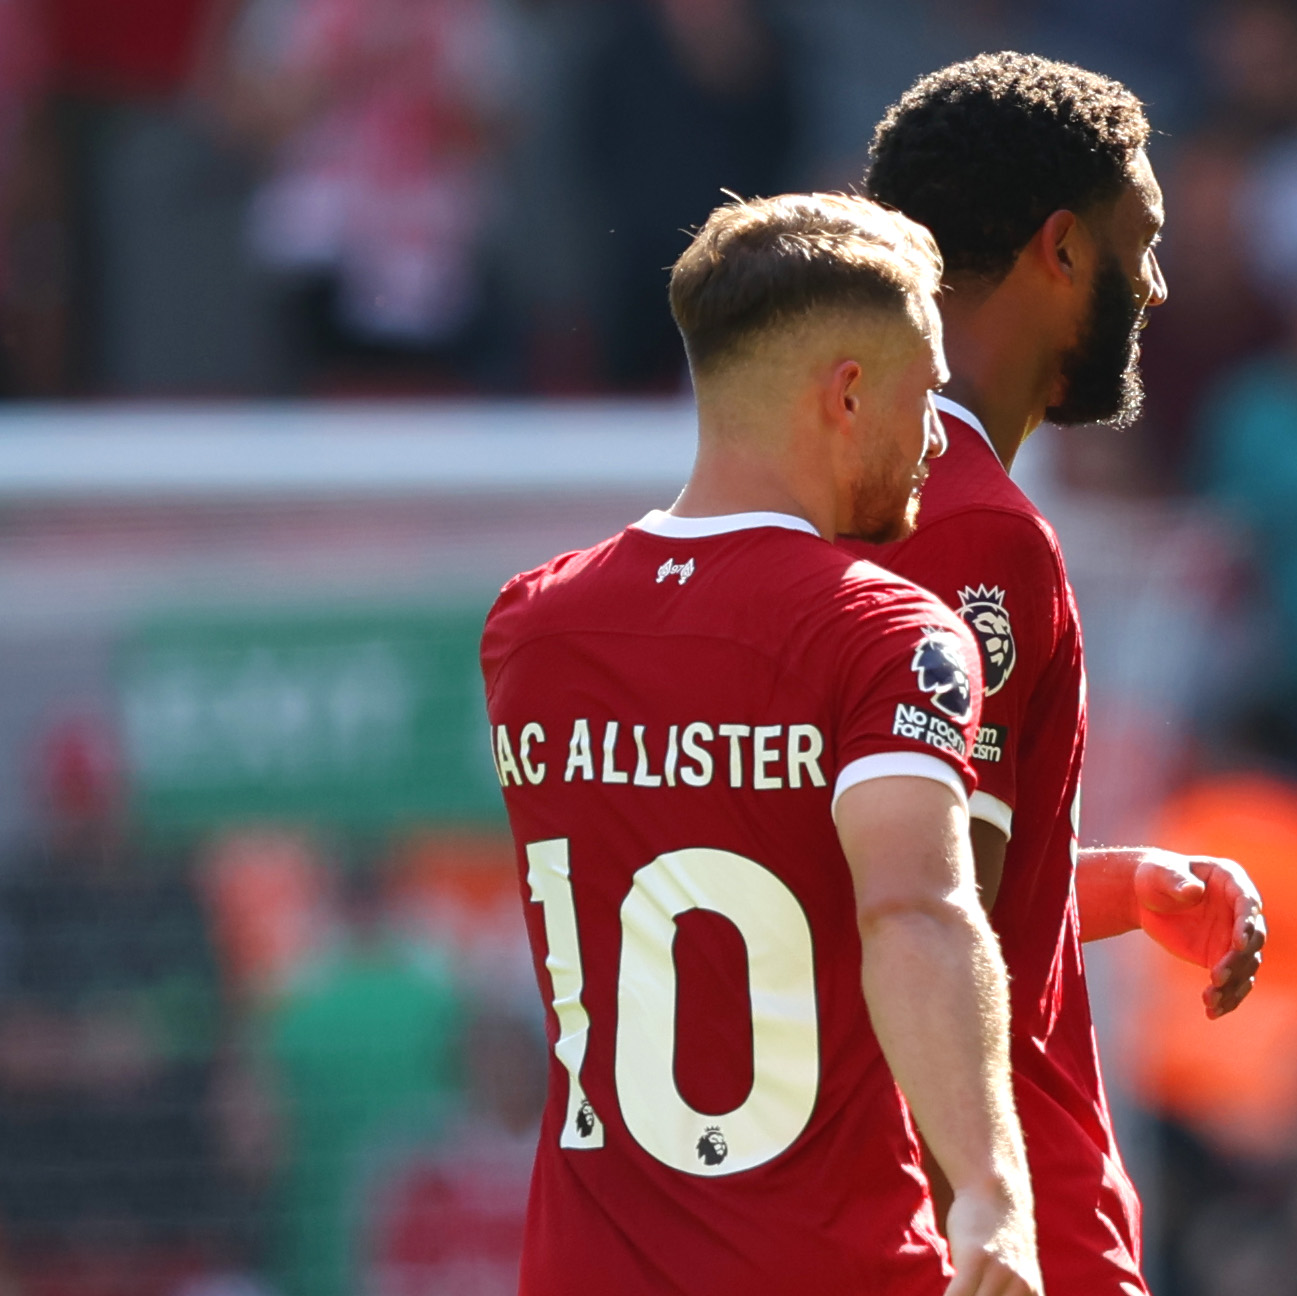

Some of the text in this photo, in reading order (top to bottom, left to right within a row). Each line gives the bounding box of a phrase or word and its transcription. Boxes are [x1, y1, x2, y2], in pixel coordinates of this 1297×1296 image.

[893, 720, 925, 740] for
[895, 703, 927, 726] No
[490, 719, 828, 790] AC ALLISTER
[526, 838, 820, 1178] 10
